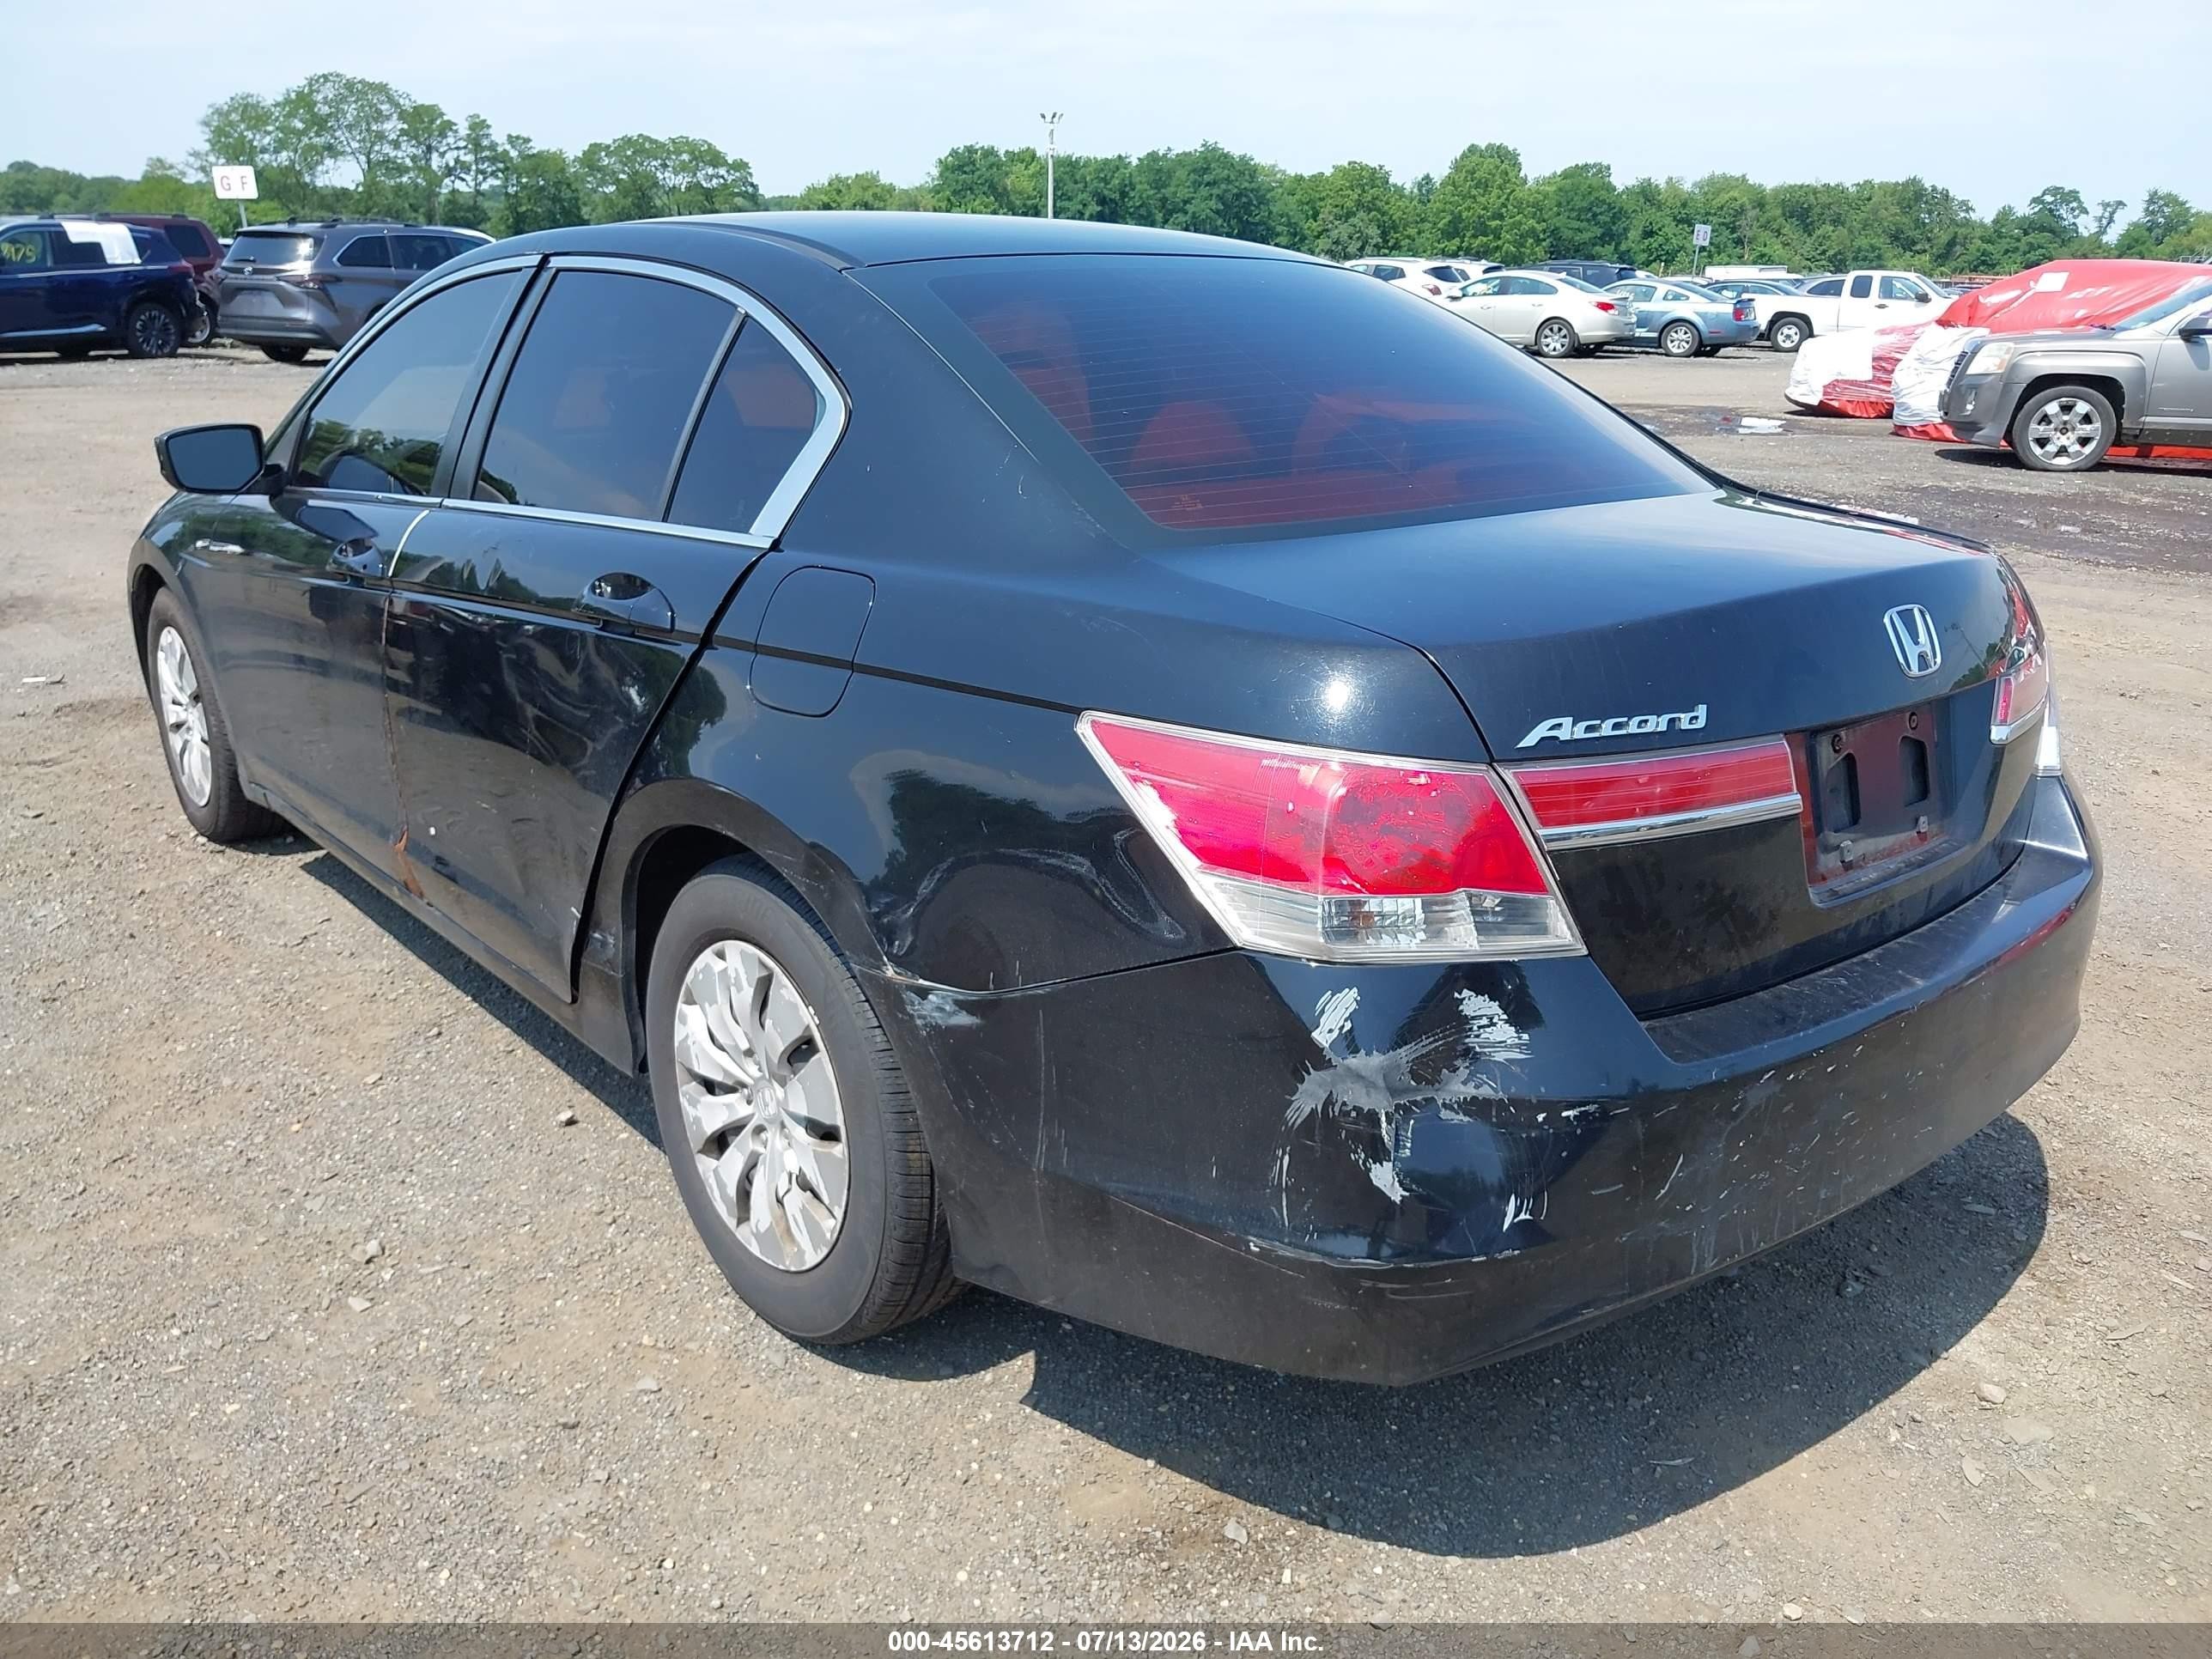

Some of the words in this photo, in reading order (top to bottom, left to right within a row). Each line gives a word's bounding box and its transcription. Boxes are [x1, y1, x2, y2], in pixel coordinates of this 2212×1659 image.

[220, 175, 232, 191] G
[240, 175, 248, 191] F
[1514, 703, 1707, 749] Accord
